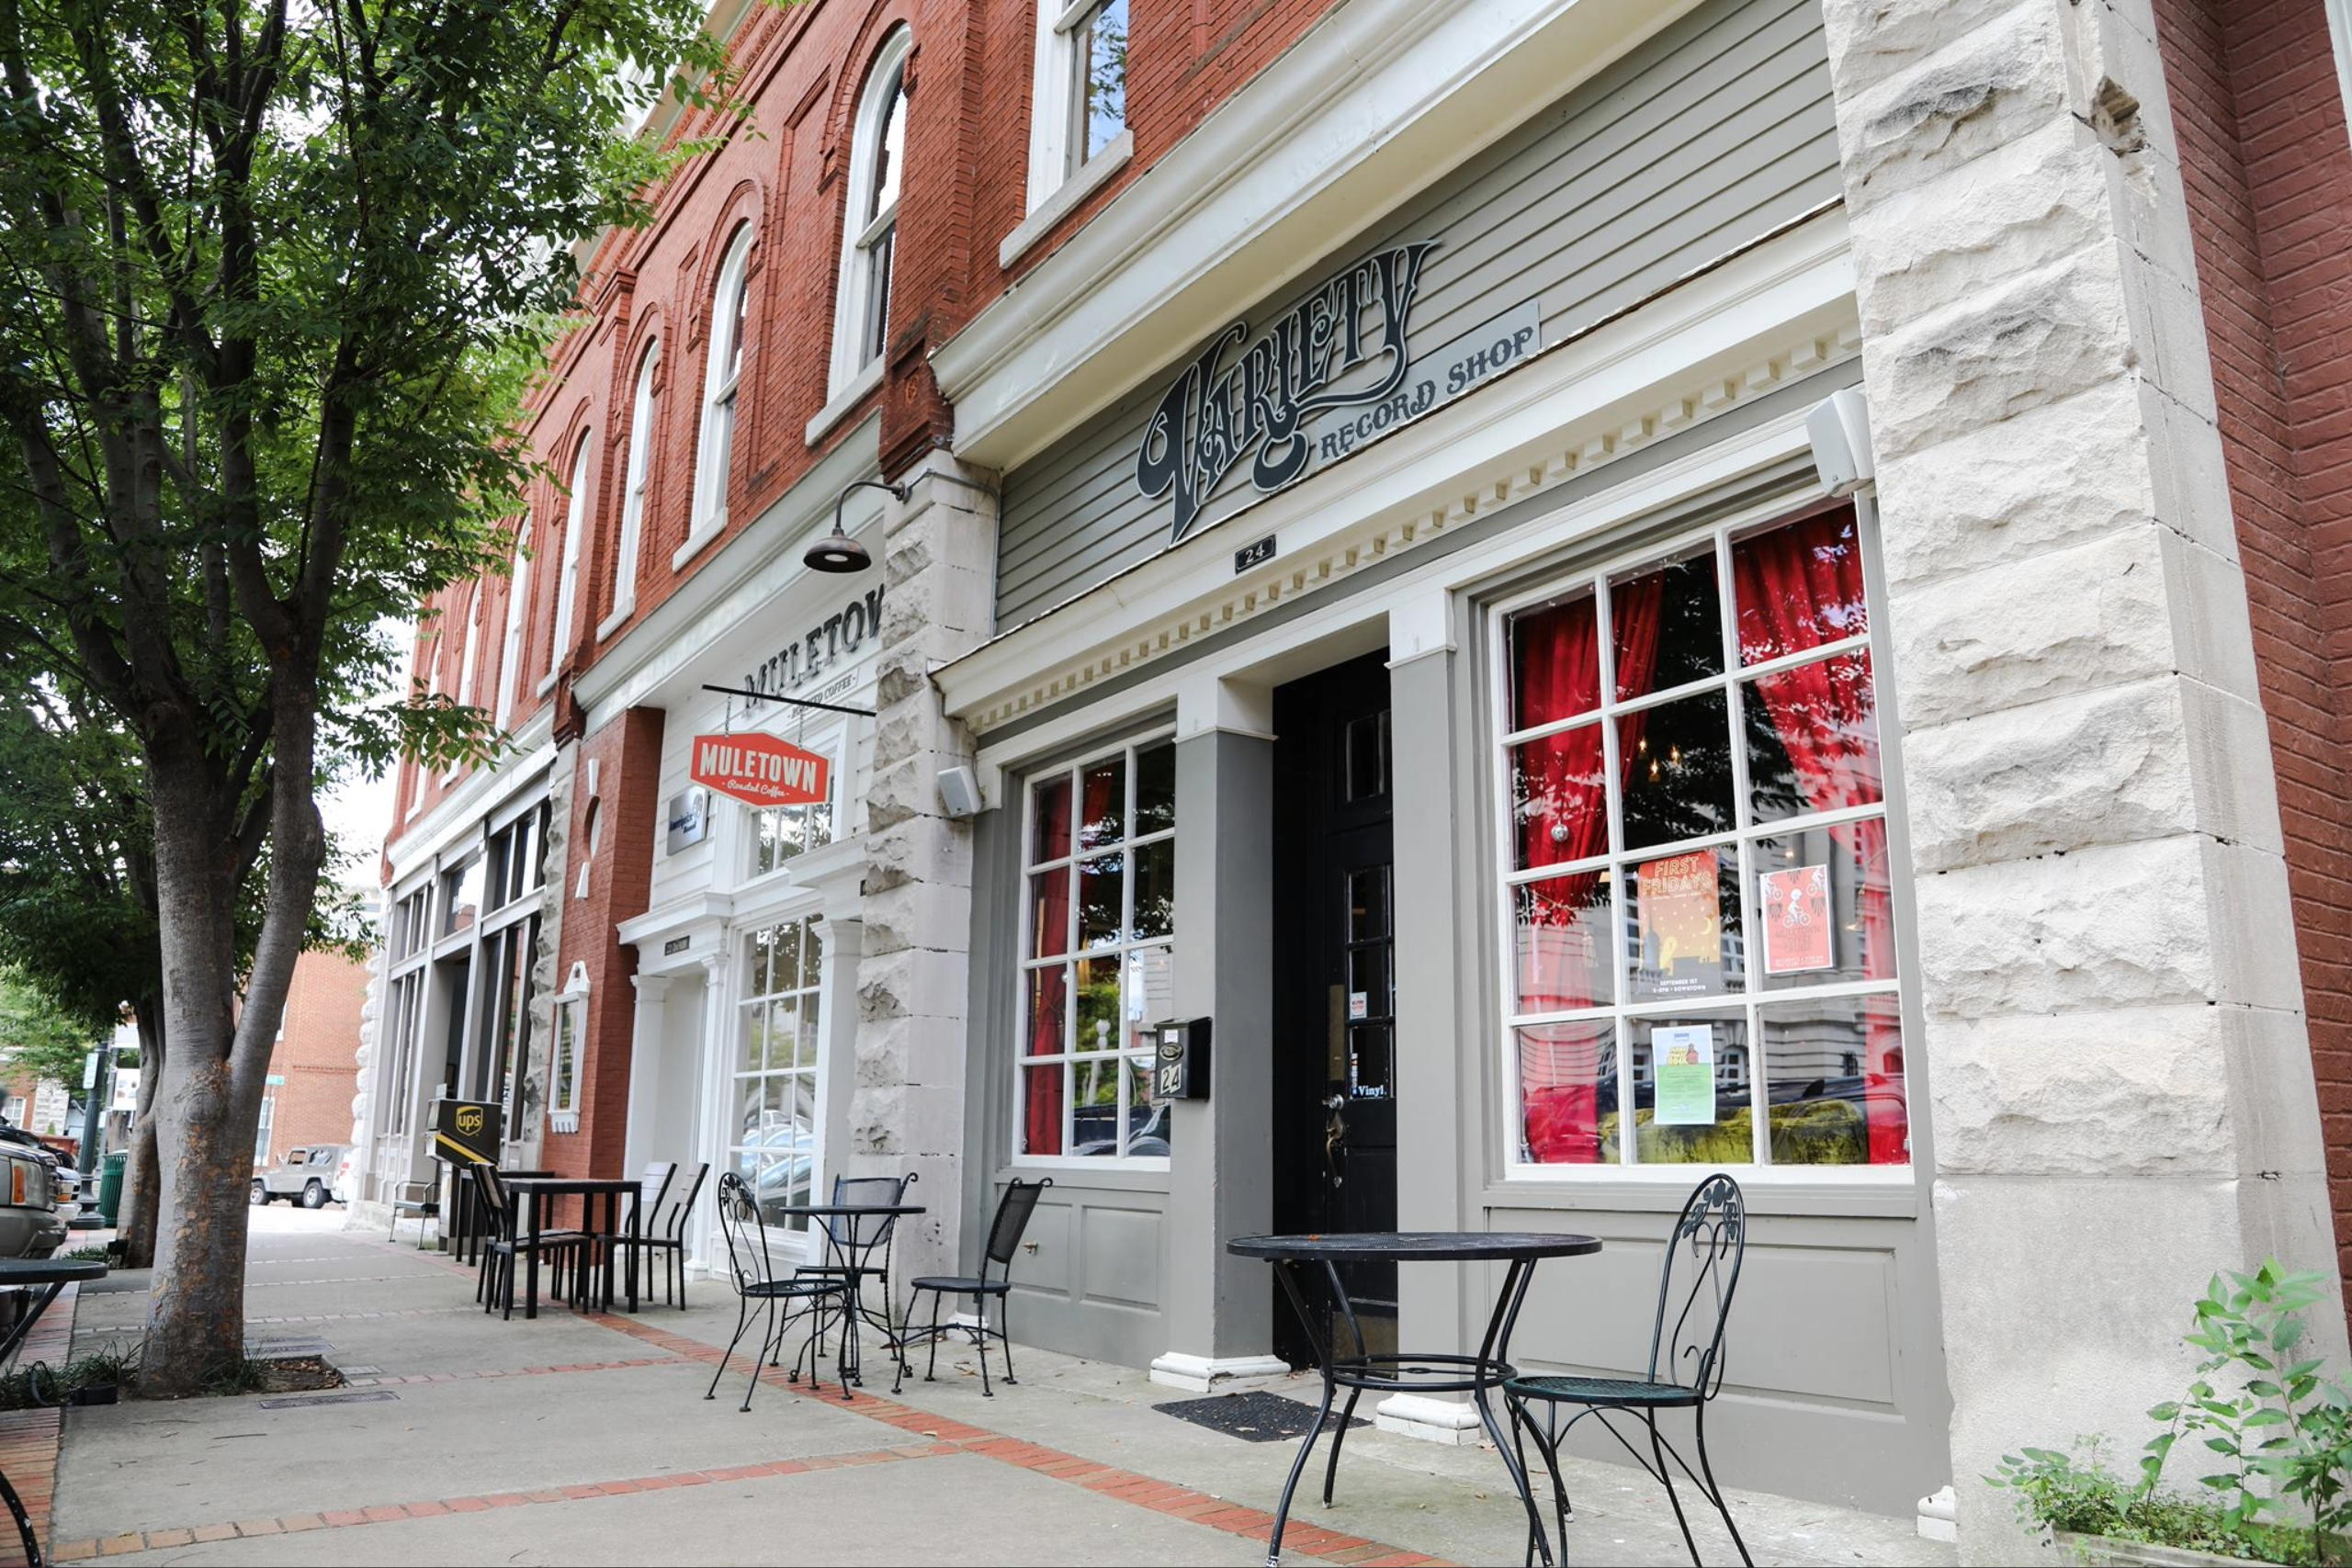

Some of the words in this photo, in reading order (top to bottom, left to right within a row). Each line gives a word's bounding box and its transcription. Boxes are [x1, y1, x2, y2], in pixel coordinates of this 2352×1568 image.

[1136, 239, 1442, 544] VARIETY
[1321, 379, 1436, 460] RECORD
[1446, 326, 1534, 396] SHOP
[1245, 542, 1265, 565] 24
[699, 742, 817, 795] MULETOWN
[727, 779, 760, 793] Roasted
[760, 784, 786, 798] Coffee
[1654, 856, 1700, 877] FIRST
[1642, 871, 1713, 896] FRIDAYS
[1659, 978, 1689, 987] SEPTEMBER
[1673, 984, 1707, 992] DOWNTOWN
[1161, 1066, 1181, 1091] 24
[458, 1114, 481, 1132] ups
